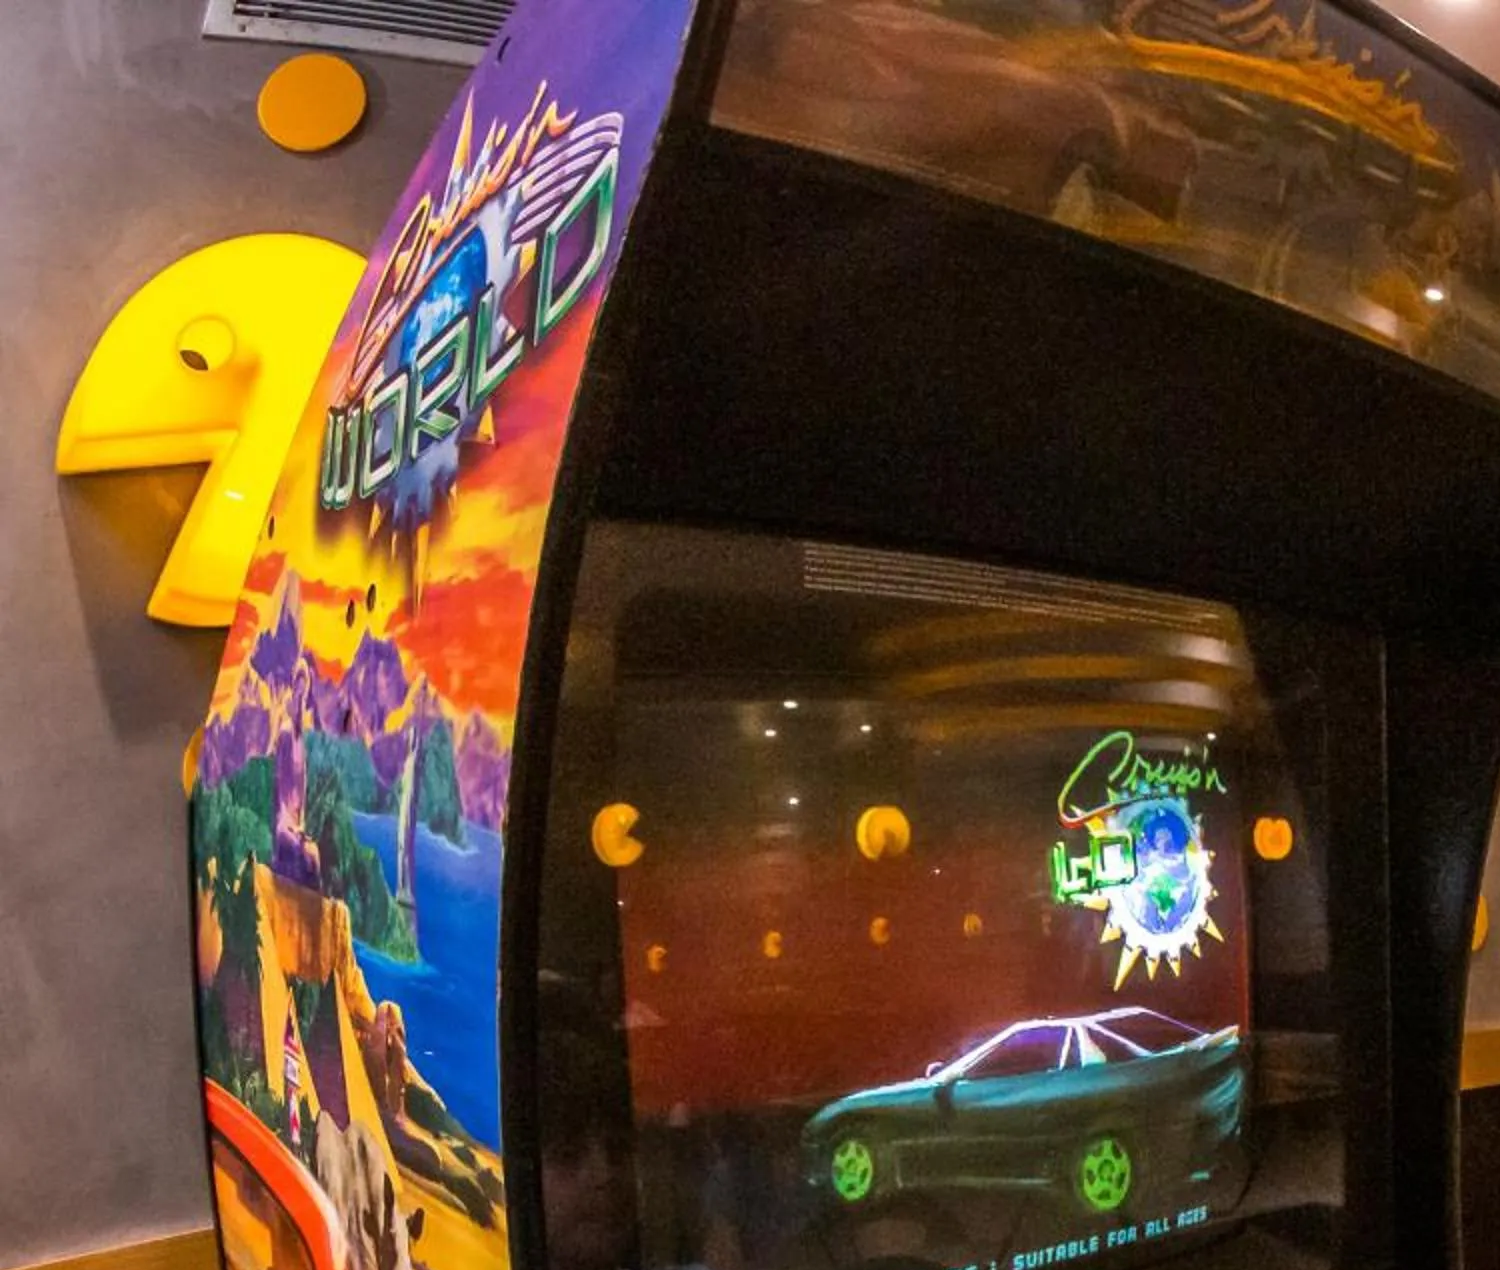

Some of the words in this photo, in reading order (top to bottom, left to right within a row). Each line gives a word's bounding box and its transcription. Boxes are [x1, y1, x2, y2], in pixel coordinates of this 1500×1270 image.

[320, 147, 621, 510] WORLD
[1107, 1228, 1137, 1249] FOR
[1144, 1219, 1171, 1239] ALL
[1176, 1205, 1208, 1229] AGES
